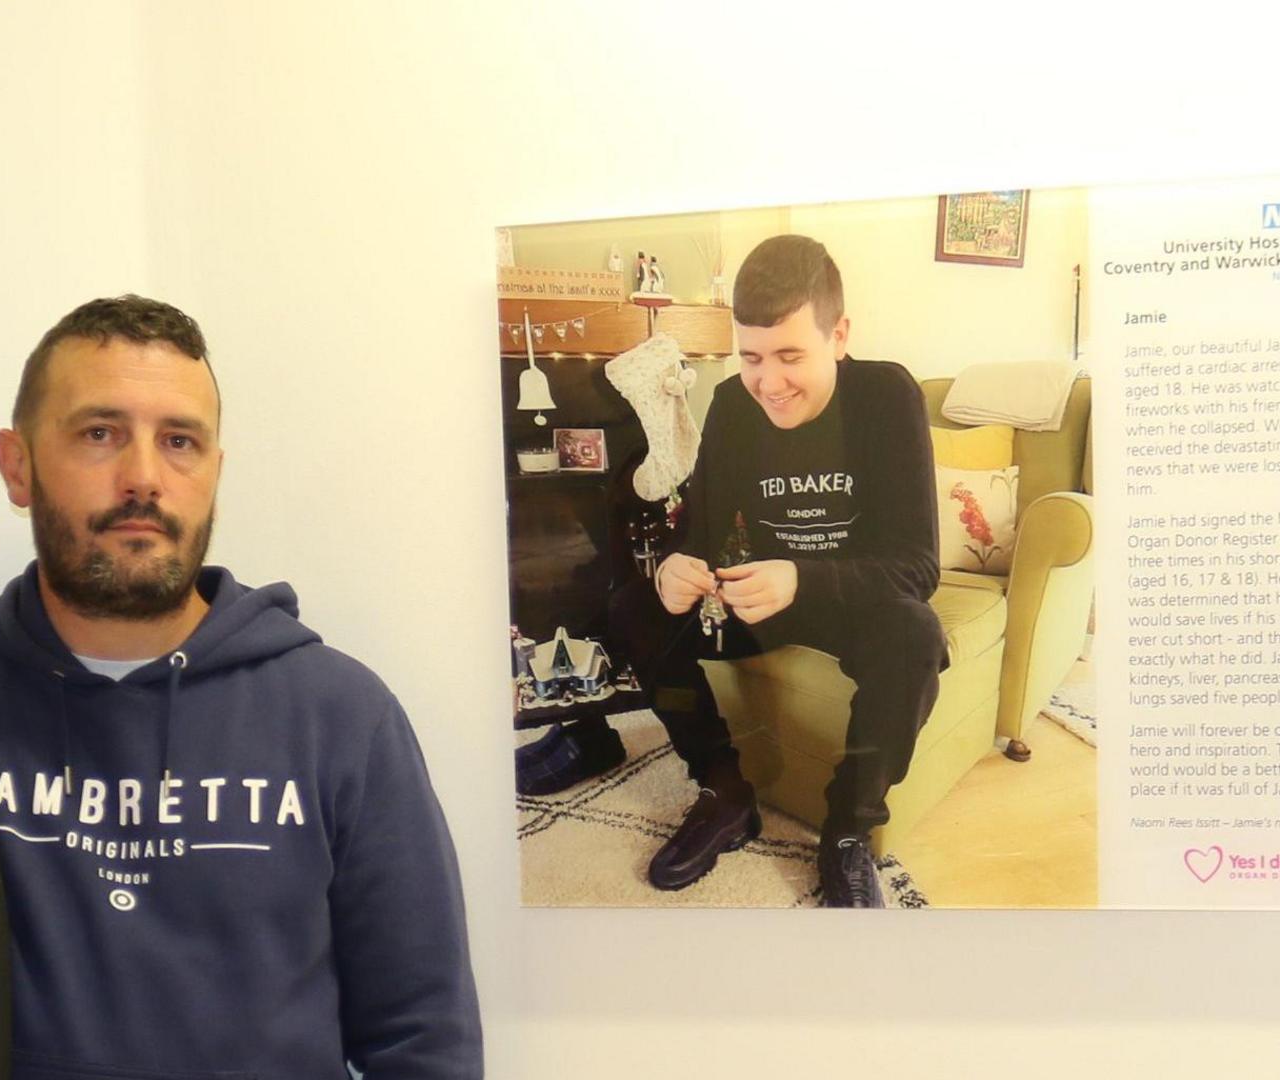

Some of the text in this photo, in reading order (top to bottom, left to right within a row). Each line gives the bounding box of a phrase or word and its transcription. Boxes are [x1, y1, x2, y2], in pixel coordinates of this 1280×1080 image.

[1164, 238, 1244, 254] University
[1104, 260, 1175, 275] Coventry
[1181, 257, 1210, 271] and
[1124, 312, 1167, 324] Jamie
[1125, 345, 1167, 358] Jamie,
[1173, 345, 1195, 356] our
[1201, 339, 1262, 355] beautiful
[1125, 363, 1180, 377] suffered
[1186, 366, 1193, 375] a
[1199, 361, 1246, 375] cardiac
[1125, 383, 1159, 400] aged
[1167, 383, 1185, 396] 18.
[1191, 382, 1210, 394] He
[1215, 383, 1242, 393] was
[1126, 403, 1189, 417] fireworks
[1194, 402, 1224, 415] with
[1229, 401, 1248, 413] his
[1126, 423, 1164, 436] when
[1169, 423, 1185, 435] he
[1191, 421, 1258, 437] collapsed.
[1127, 443, 1182, 456] received
[1188, 442, 1209, 454] the
[1127, 464, 1162, 476] news
[1167, 463, 1193, 475] that
[1200, 463, 1219, 473] we
[1224, 462, 1258, 472] were
[760, 473, 853, 498] TED BAKER
[1127, 483, 1156, 496] him.
[786, 508, 826, 518] LONDON
[1128, 516, 1165, 528] Jamie
[1171, 515, 1196, 527] had
[1201, 513, 1246, 530] signed
[1251, 512, 1273, 524] the
[1128, 533, 1278, 551] Organ Donor Register
[1128, 555, 1163, 567] three
[1168, 554, 1204, 567] times
[1210, 554, 1221, 565] in
[1226, 553, 1245, 565] his
[1128, 574, 1166, 590] (aged
[1173, 573, 1193, 588] 16,
[1200, 573, 1214, 585] 17
[1221, 573, 1231, 585] &
[1238, 572, 1262, 586] 18).
[1129, 596, 1155, 607] was
[1160, 593, 1238, 606] determined
[1244, 592, 1271, 604] that
[1129, 613, 1170, 627] would
[1176, 615, 1205, 625] save
[1210, 612, 1239, 625] lives
[1244, 612, 1251, 624] if
[1256, 611, 1275, 624] his
[1129, 635, 1156, 646] ever
[1162, 633, 1183, 645] cut
[1188, 632, 1222, 645] short
[1237, 632, 1263, 644] and
[1129, 653, 1175, 668] exactly
[1180, 652, 1214, 665] what
[1219, 652, 1236, 664] he
[1241, 652, 1266, 664] did.
[1129, 672, 1184, 687] kidneys,
[1189, 672, 1219, 686] liver,
[1130, 692, 1165, 707] lungs
[1170, 691, 1208, 704] saved
[1214, 690, 1238, 704] five
[1130, 725, 1168, 737] Jamie
[1173, 724, 1196, 737] will
[1200, 723, 1247, 737] forever
[1253, 723, 1269, 736] be
[1130, 744, 1160, 756] hero
[1166, 744, 1191, 756] and
[1196, 743, 1271, 759] inspiration.
[1130, 763, 1169, 777] world
[1174, 763, 1216, 776] would
[1221, 763, 1237, 776] be
[1243, 766, 1250, 775] a
[1130, 783, 1166, 799] place
[1170, 782, 1178, 795] if
[1184, 783, 1192, 795] it
[1197, 785, 1224, 796] was
[1228, 782, 1249, 795] full
[1254, 782, 1268, 795] of
[1130, 818, 1165, 828] Naomi
[1170, 818, 1193, 828] Rees
[65, 830, 184, 860] ORIGINALS
[1229, 855, 1255, 868] Yes
[1260, 855, 1265, 868] I
[98, 867, 149, 885] LONDON
